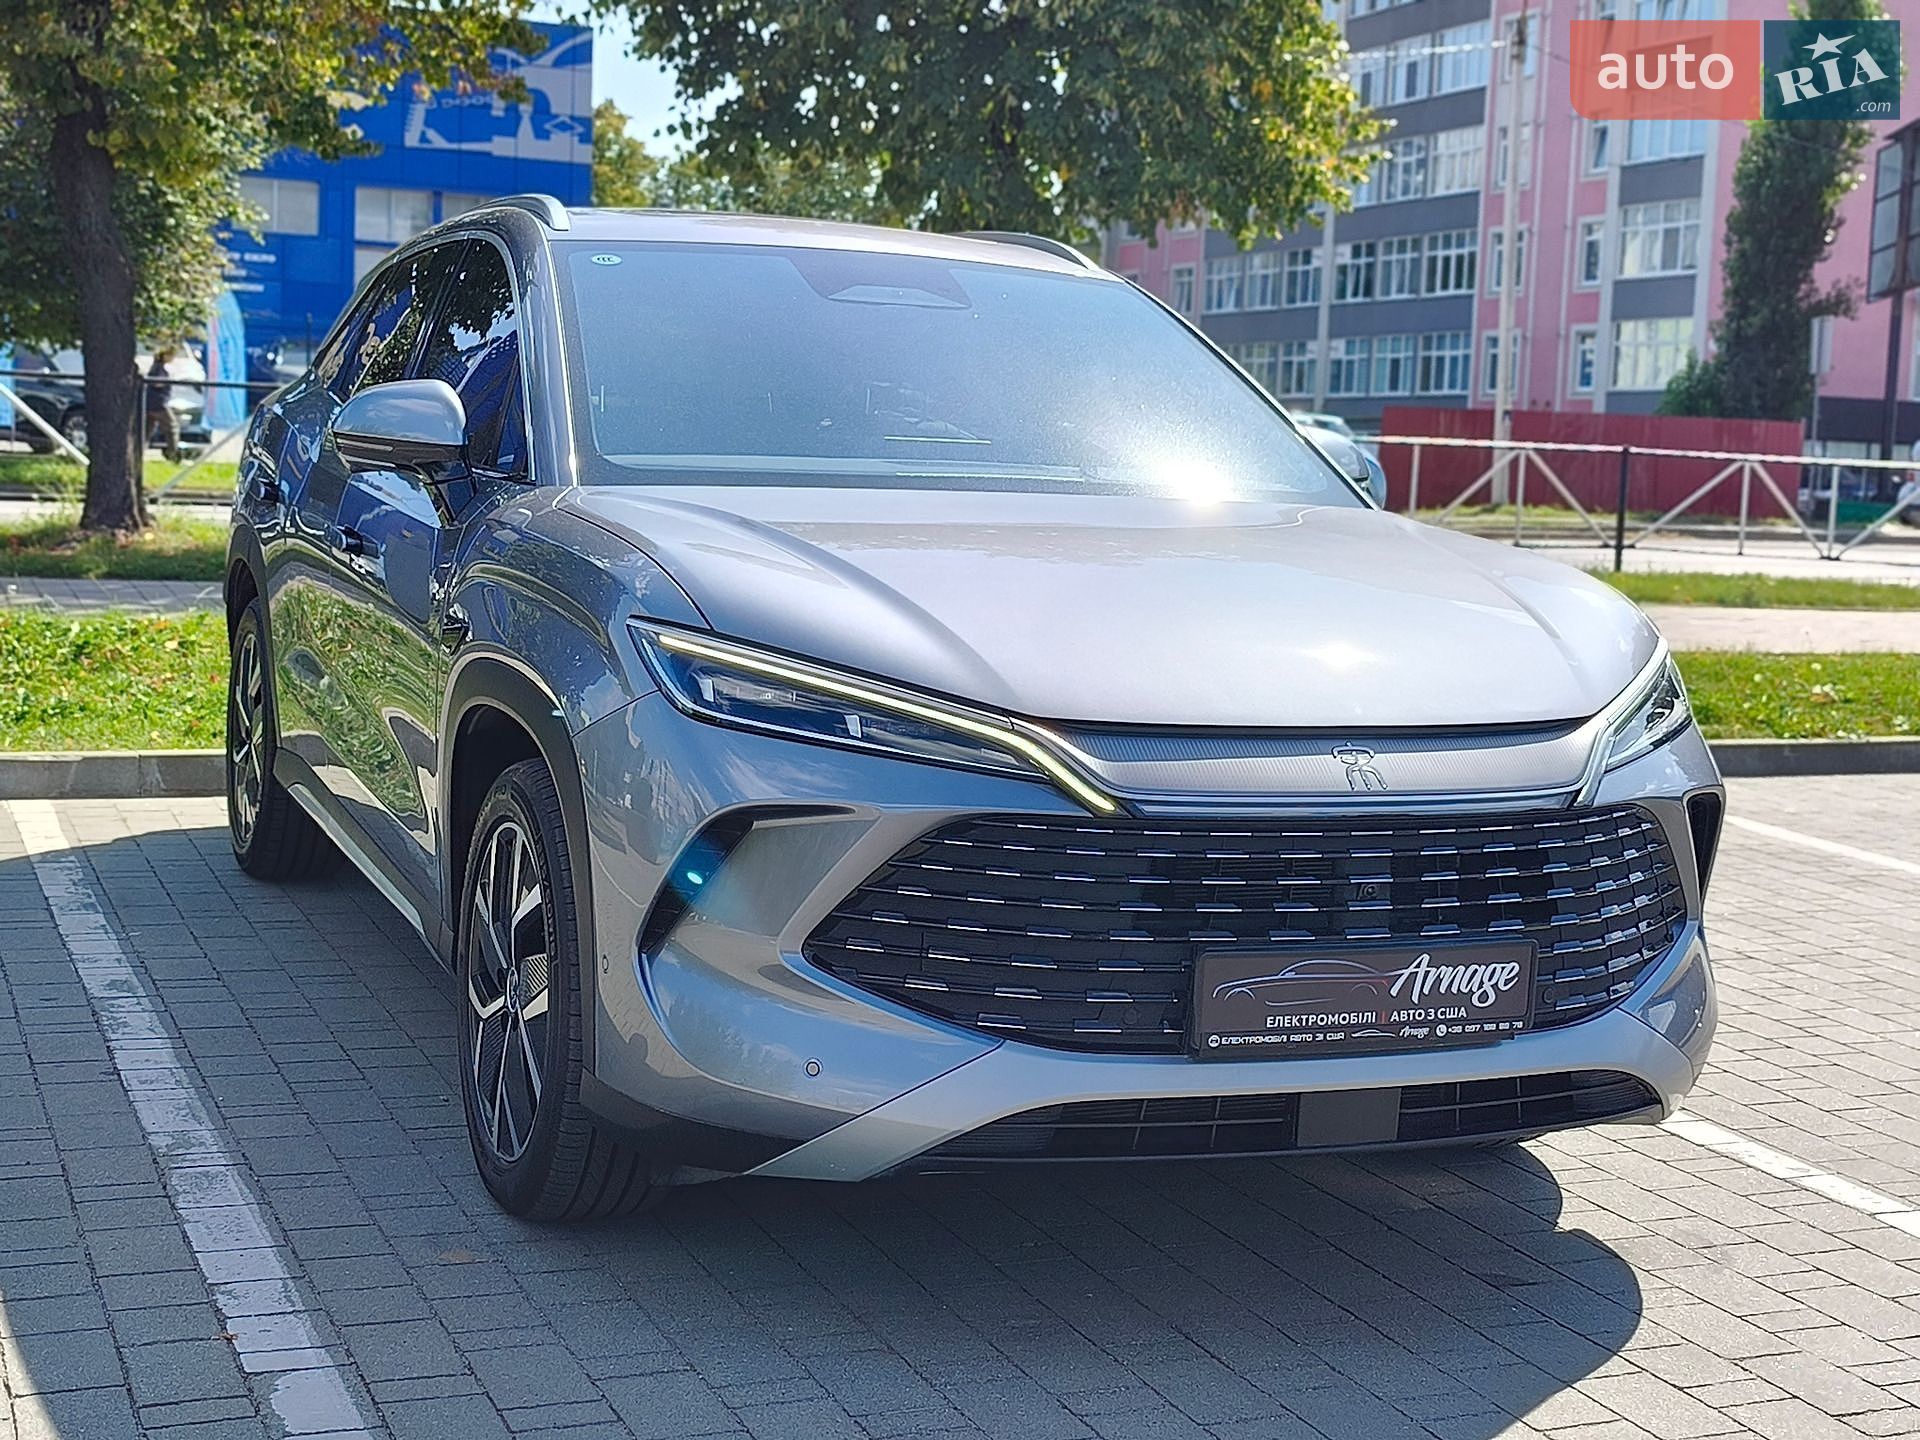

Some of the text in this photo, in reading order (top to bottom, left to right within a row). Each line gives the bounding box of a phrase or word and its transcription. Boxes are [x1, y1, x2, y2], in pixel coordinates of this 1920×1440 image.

[1389, 953, 1520, 1008] Arnage
[1266, 1011, 1376, 1028] ЕЛЕКТРОМОБІЛІ
[1390, 1009, 1424, 1022] АВТО
[1437, 1007, 1467, 1019] США
[1221, 1035, 1288, 1045] ЕЛЕКТРОМОБІЛІ
[1289, 1034, 1313, 1042] АВТО
[1326, 1032, 1345, 1040] США
[1399, 1026, 1430, 1038] Arnage
